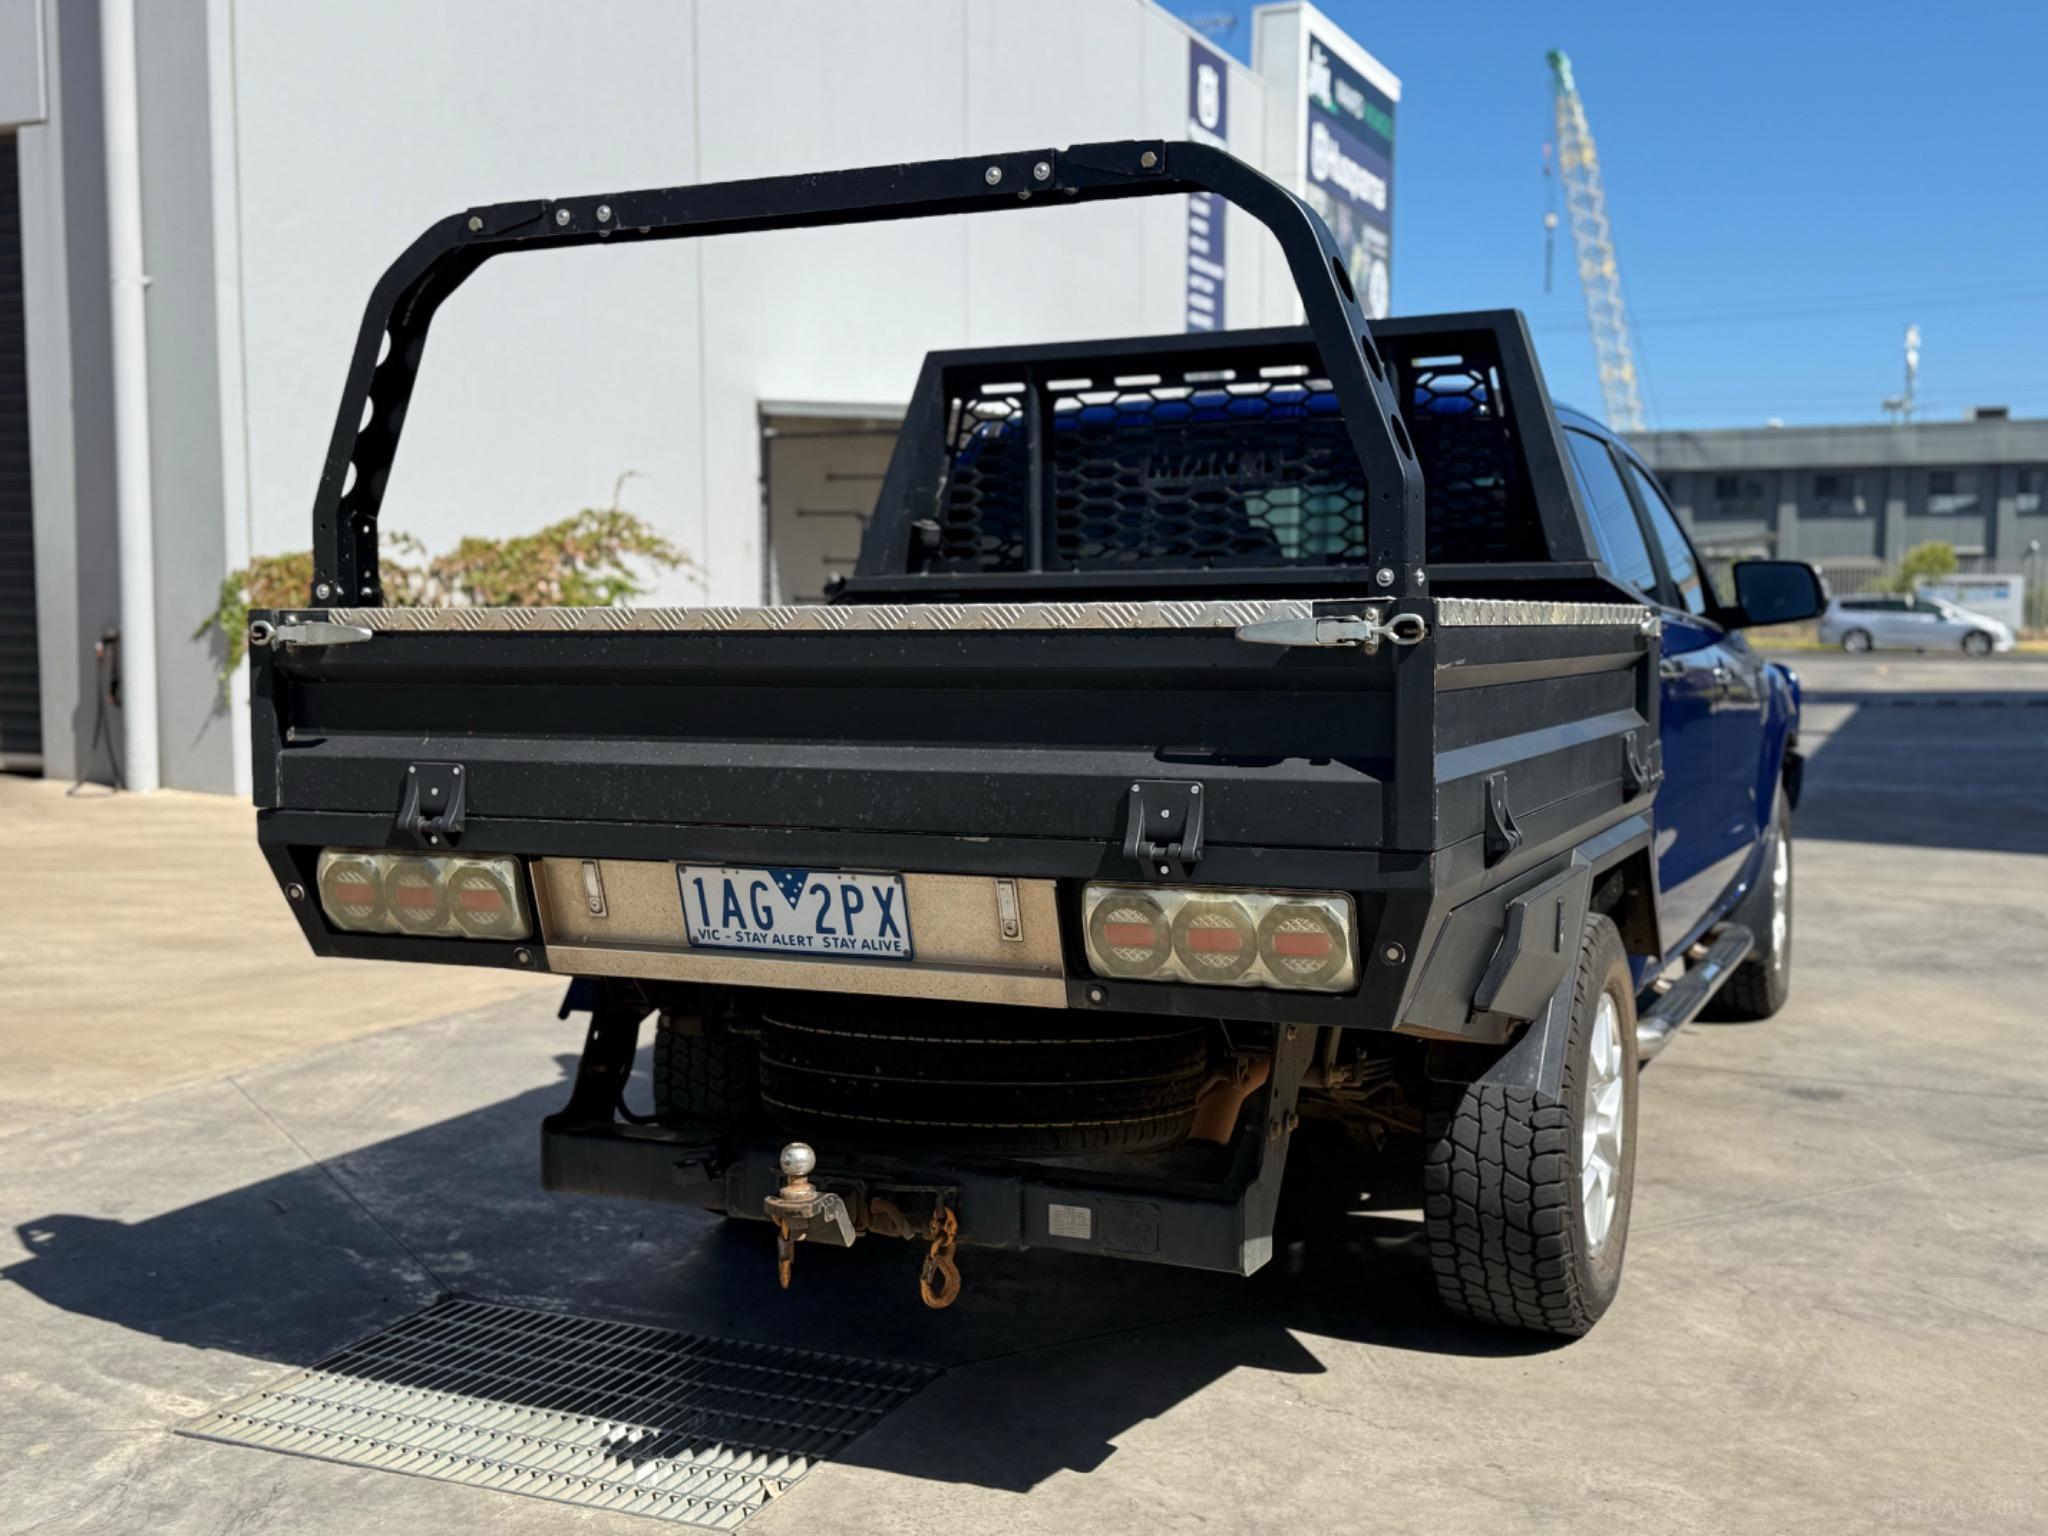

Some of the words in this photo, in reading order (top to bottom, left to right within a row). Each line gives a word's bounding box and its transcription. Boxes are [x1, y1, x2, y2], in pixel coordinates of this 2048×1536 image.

[692, 876, 774, 932] 1AG
[809, 882, 902, 939] 2PX
[697, 928, 721, 941] VIC
[735, 930, 769, 944] STAY
[772, 933, 814, 947] ALERT
[823, 936, 857, 950] STAY
[861, 938, 902, 951] ALIVE
